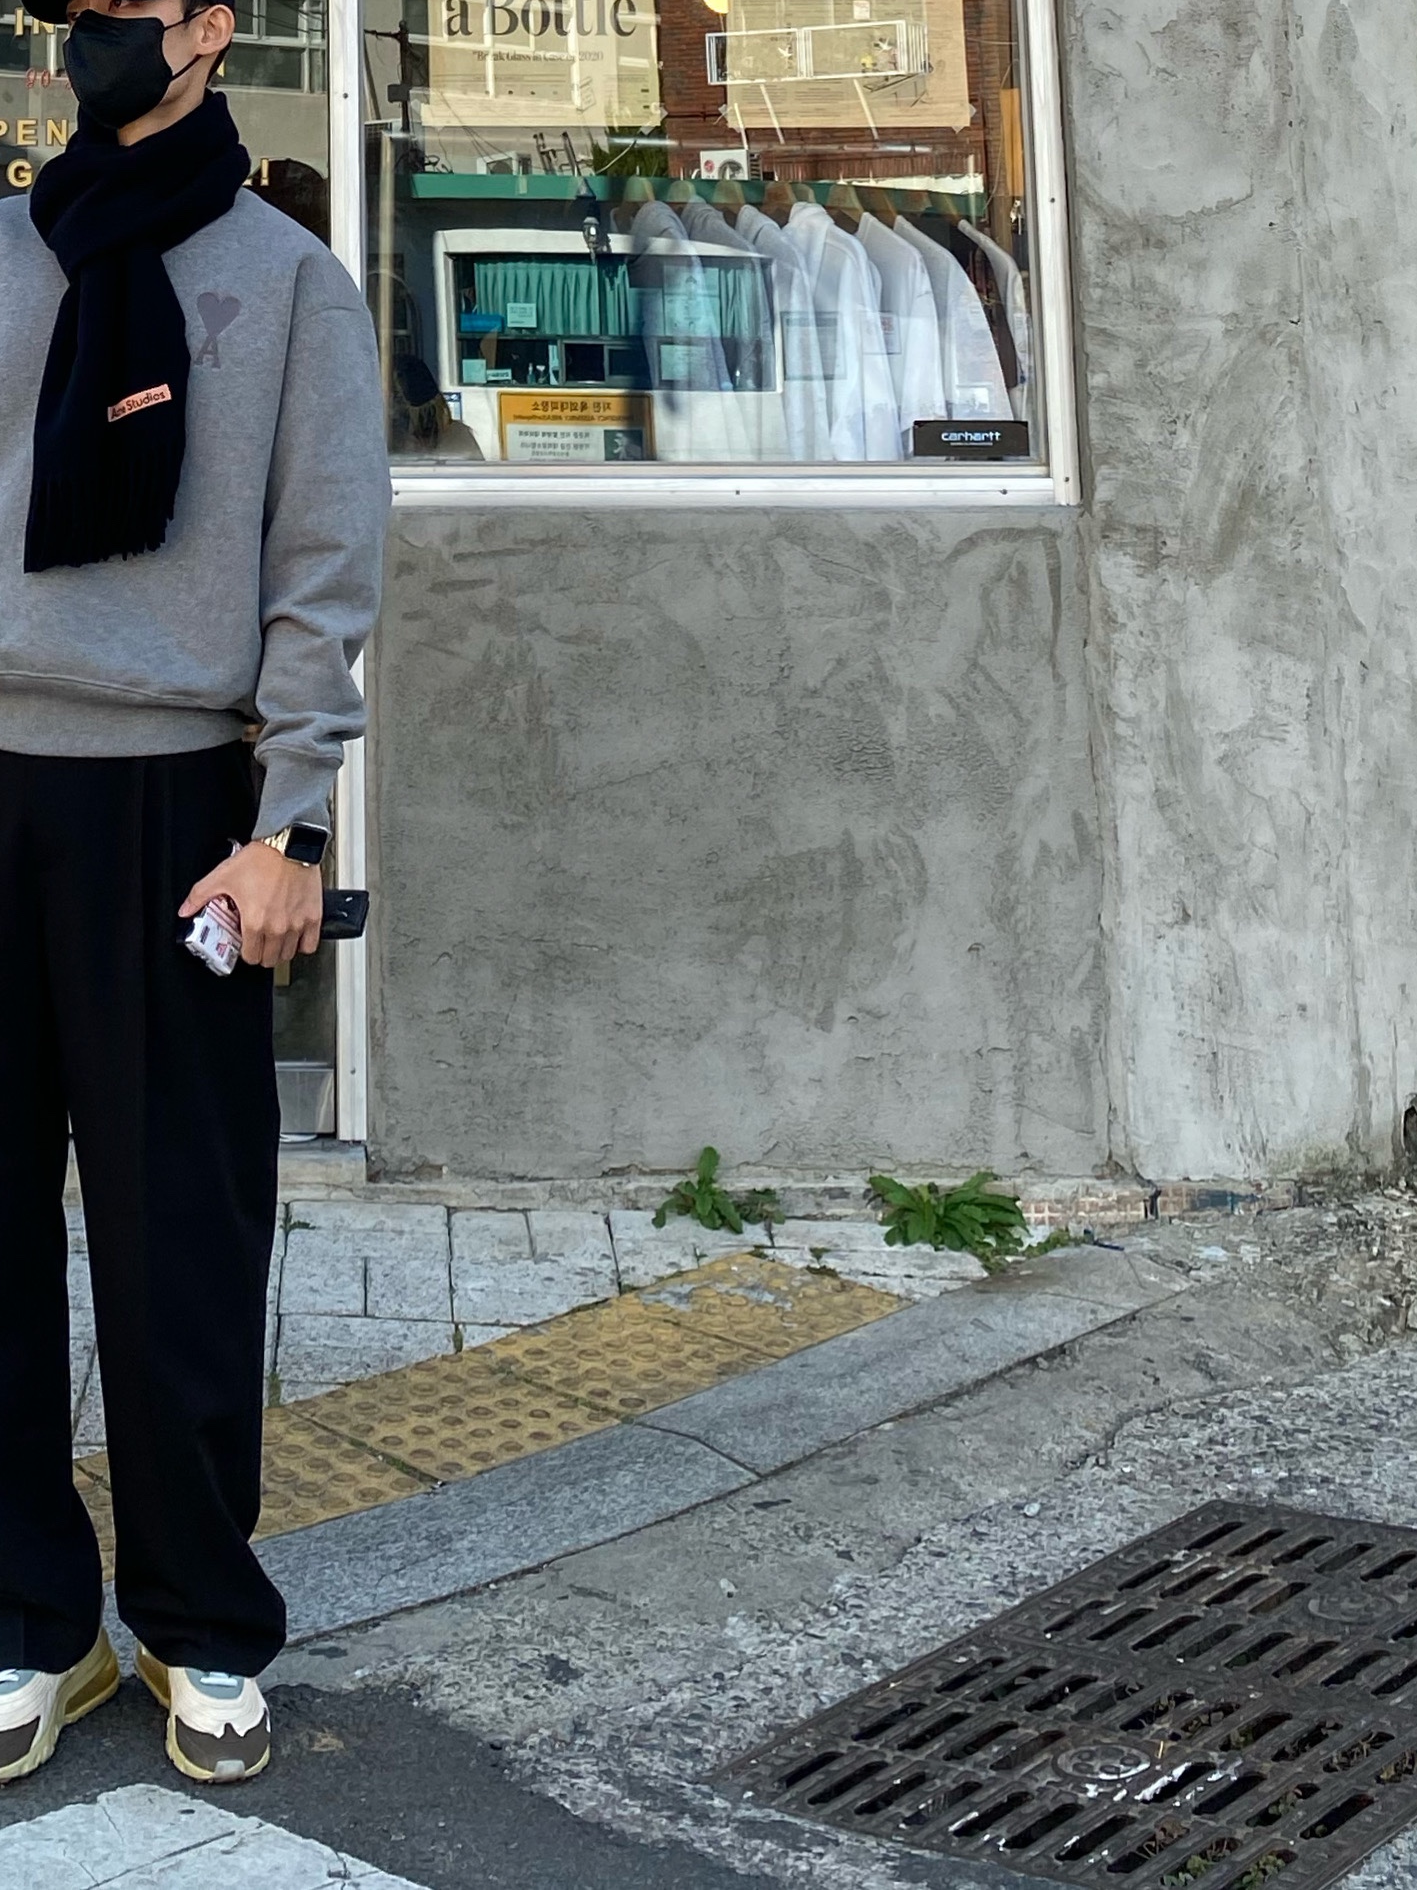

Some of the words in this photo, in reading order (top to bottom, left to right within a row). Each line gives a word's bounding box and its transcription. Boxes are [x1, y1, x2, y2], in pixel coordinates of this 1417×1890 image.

[578, 50, 604, 61] 2020
[125, 390, 166, 411] Studios
[941, 431, 1001, 442] carhartt
